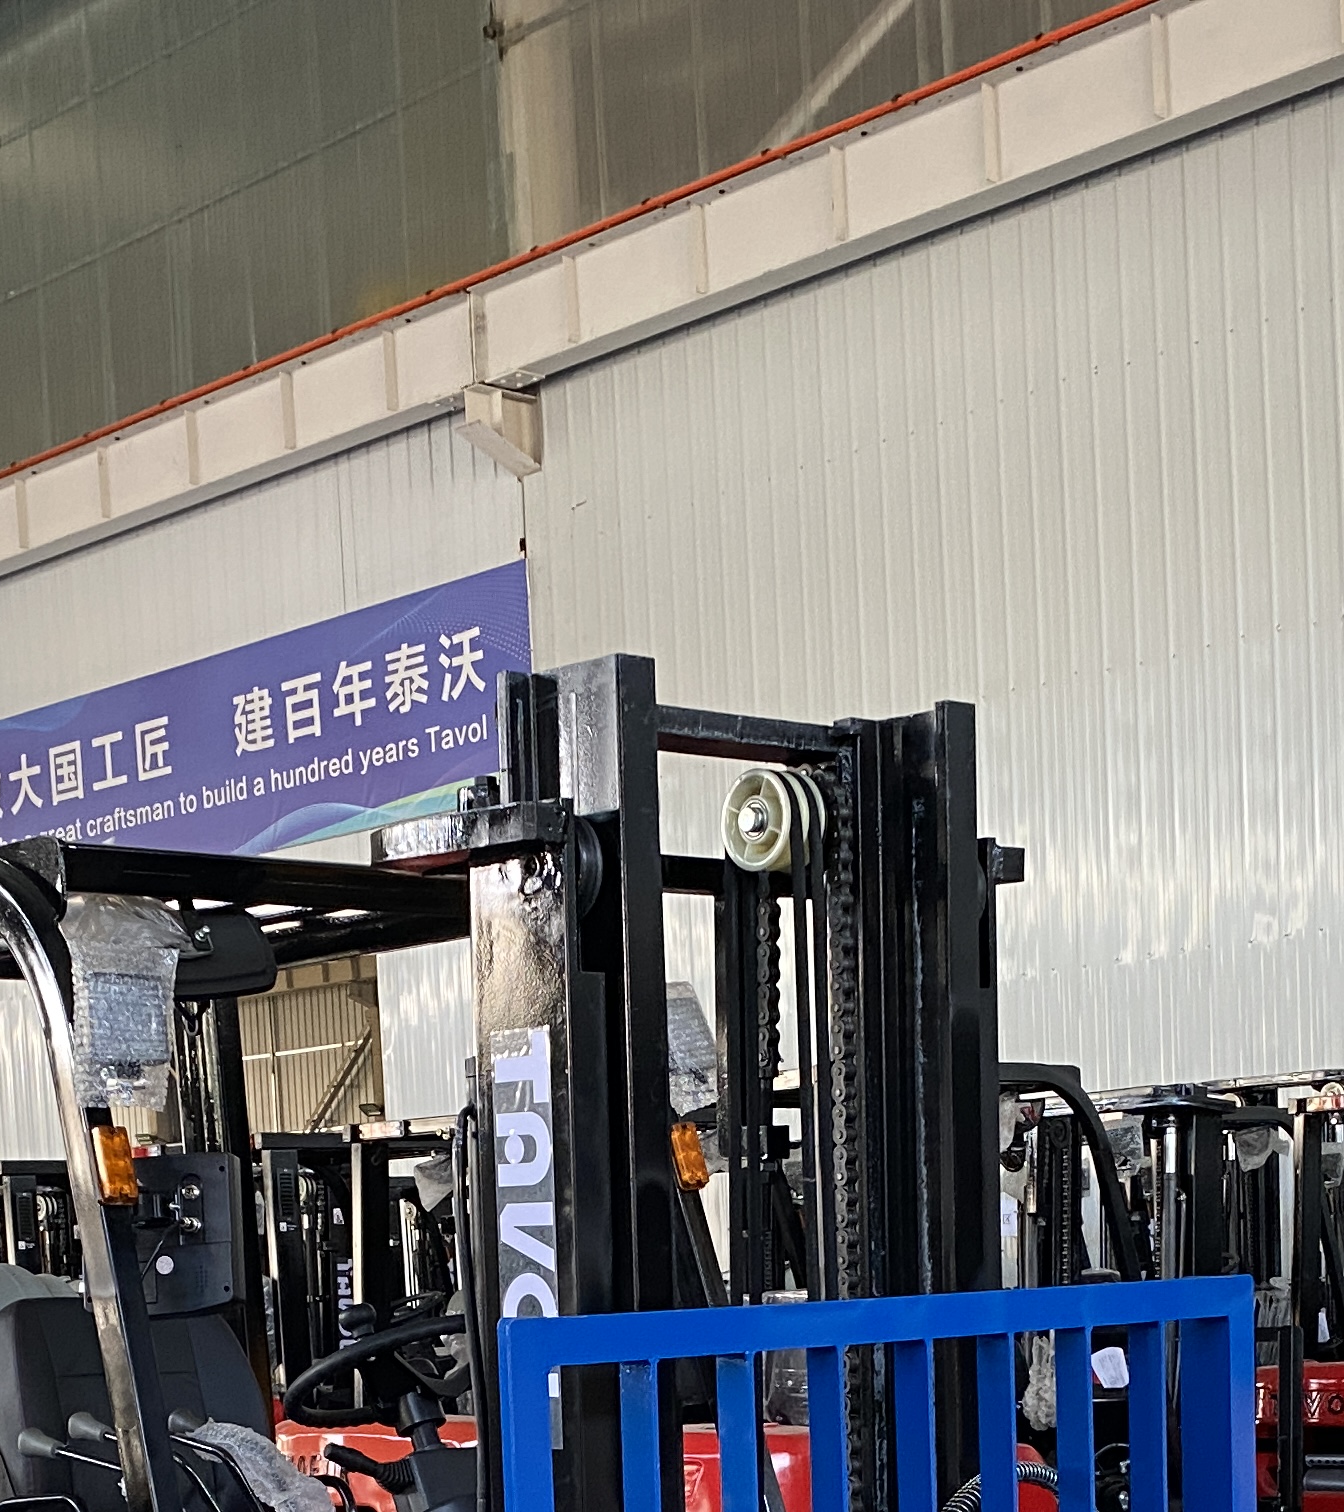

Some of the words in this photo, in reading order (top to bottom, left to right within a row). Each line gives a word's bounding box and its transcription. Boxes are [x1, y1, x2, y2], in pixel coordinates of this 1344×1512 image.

[231, 625, 487, 757] 建百年泰沃
[39, 818, 82, 842] reat
[86, 799, 175, 838] craftsman
[178, 790, 197, 815] to
[202, 776, 248, 809] build
[253, 777, 266, 796] a
[270, 748, 354, 793] hundred
[359, 737, 419, 775] years
[425, 714, 488, 753] Tavol
[495, 1030, 560, 1397] TAVO
